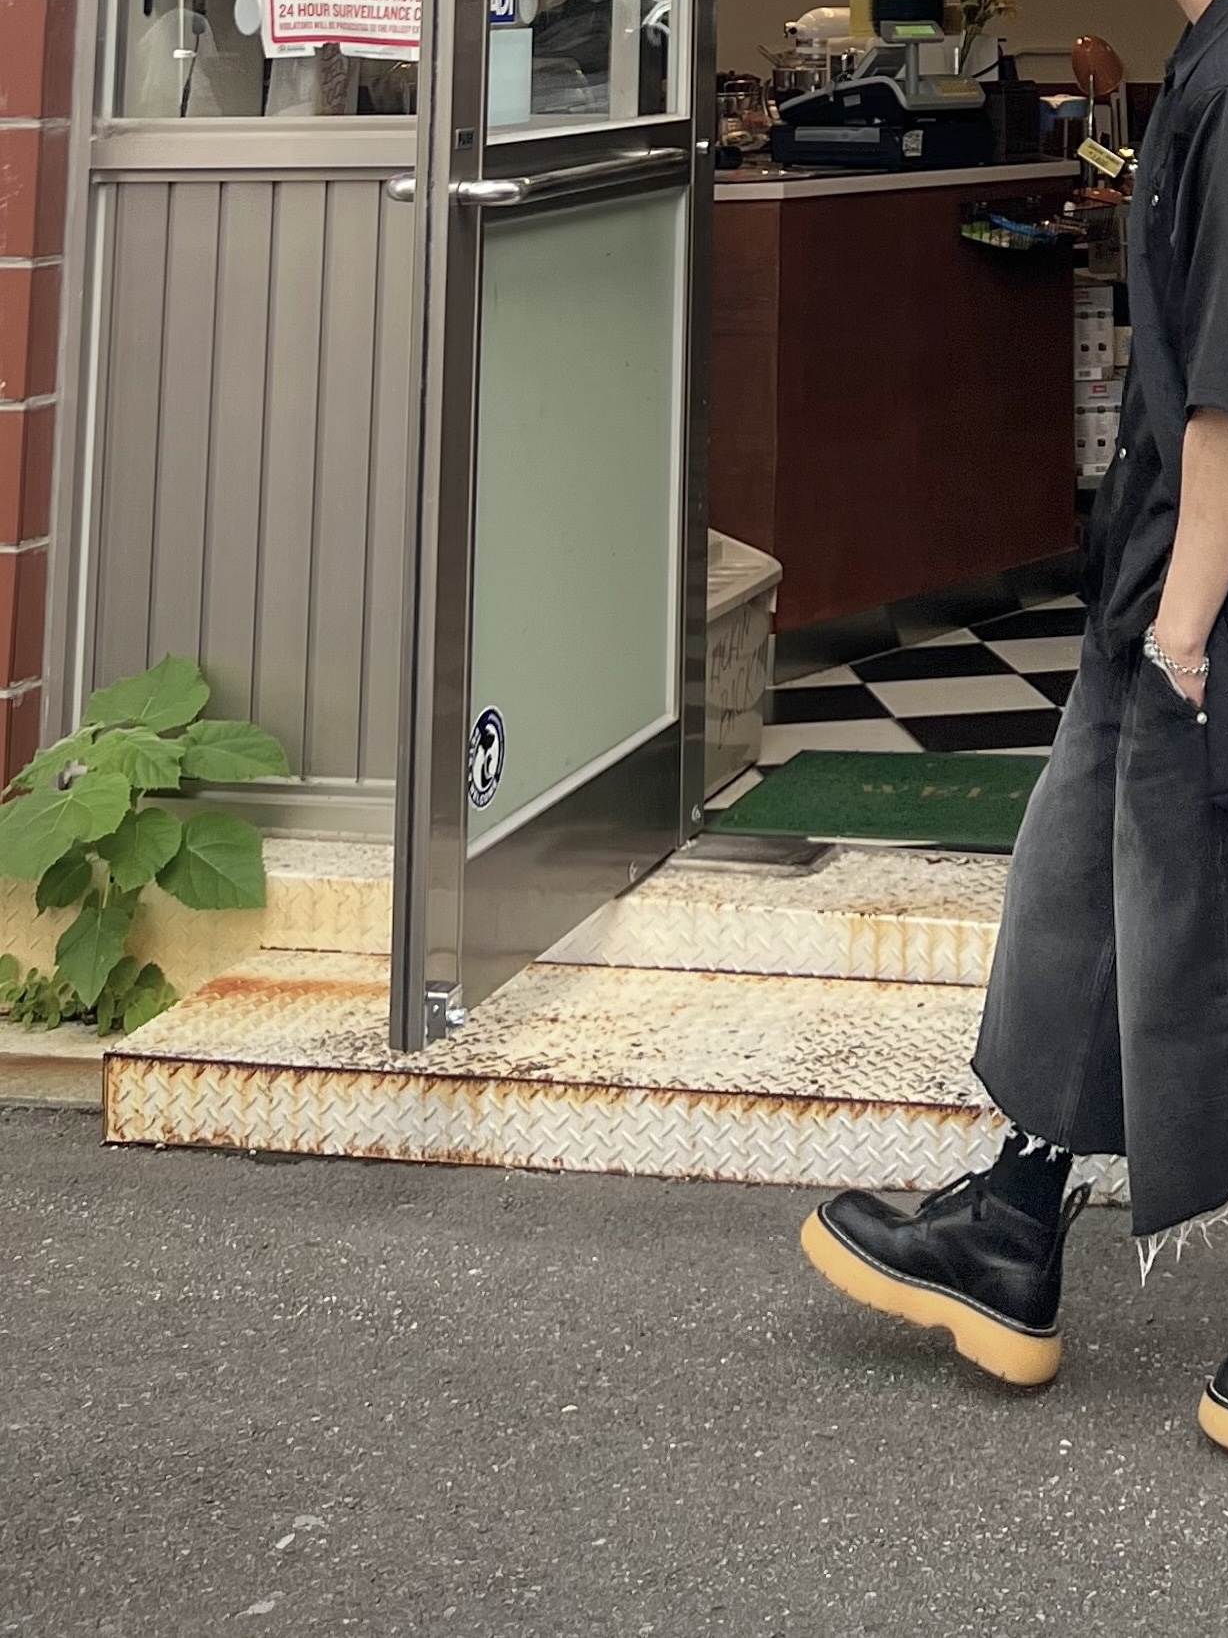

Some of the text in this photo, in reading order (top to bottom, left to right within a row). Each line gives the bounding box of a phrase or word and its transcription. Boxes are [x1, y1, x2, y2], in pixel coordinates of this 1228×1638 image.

[279, 4, 295, 18] 24
[297, 3, 331, 18] HOUR
[333, 4, 413, 21] SURVEILLANCE
